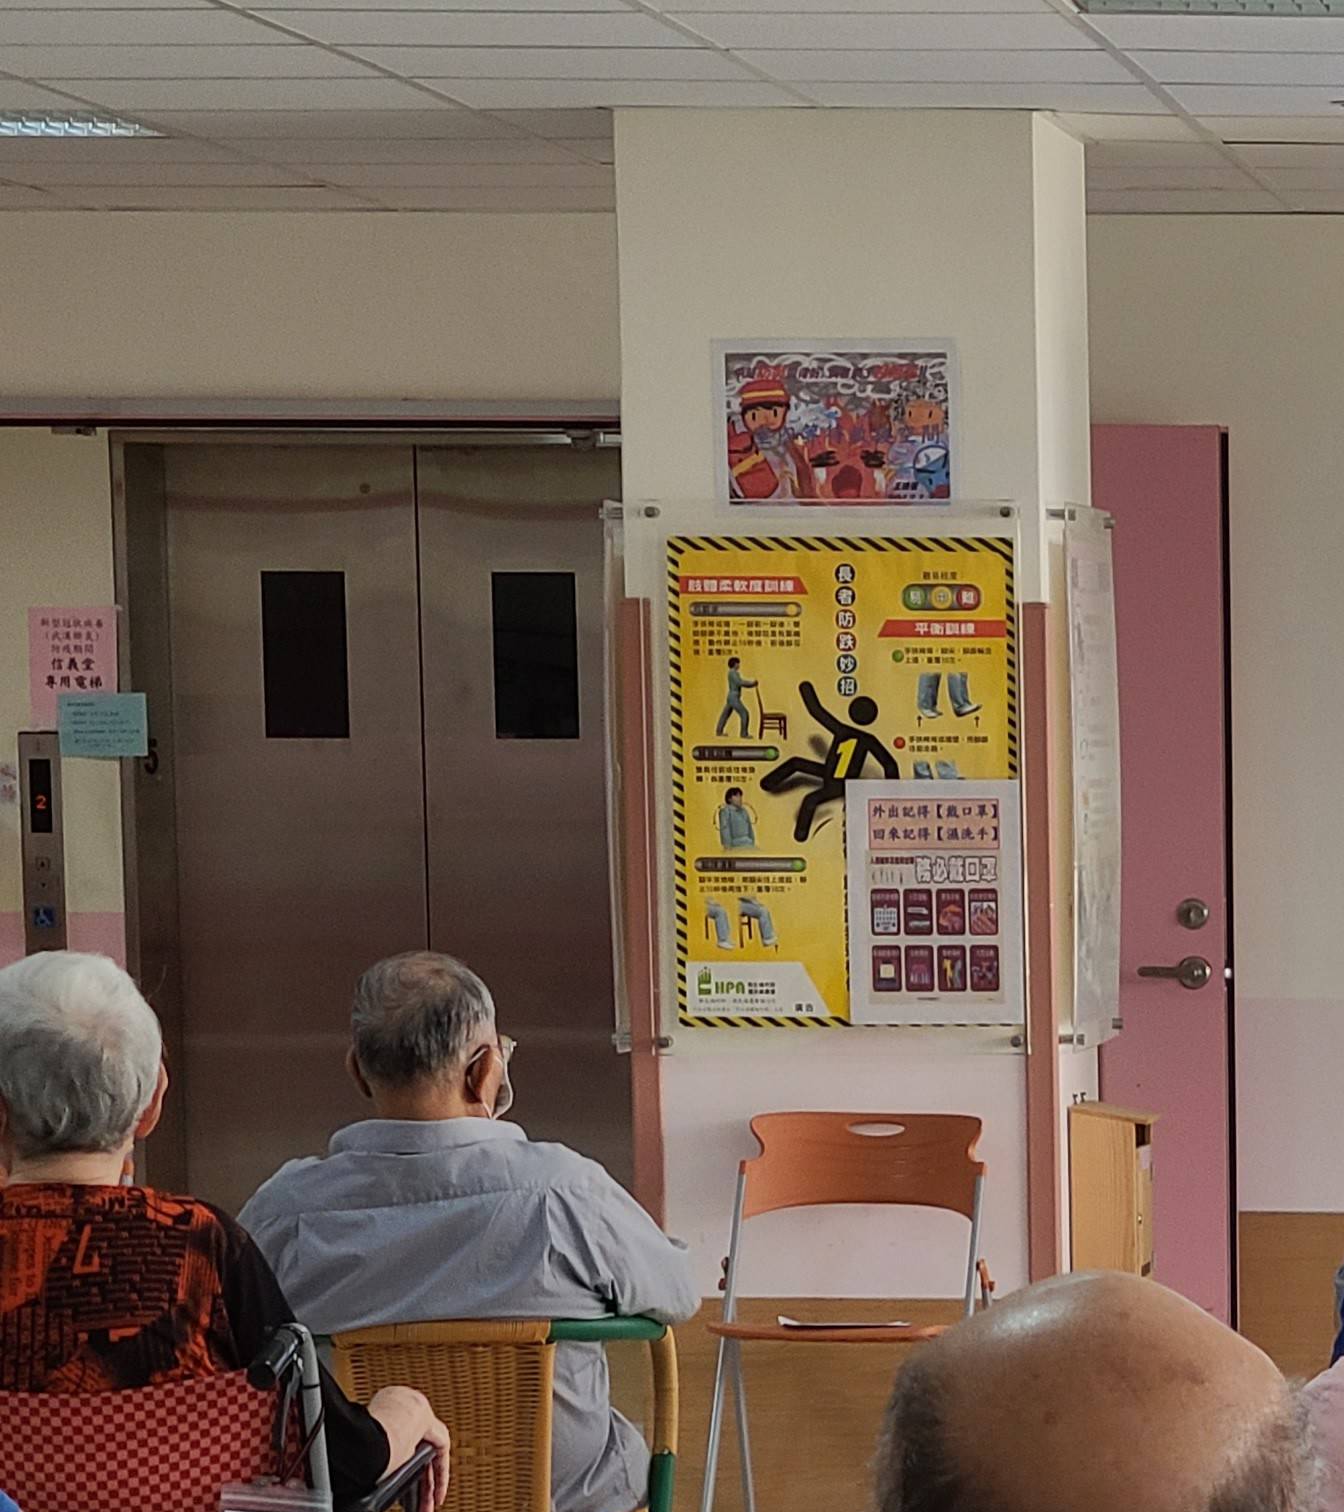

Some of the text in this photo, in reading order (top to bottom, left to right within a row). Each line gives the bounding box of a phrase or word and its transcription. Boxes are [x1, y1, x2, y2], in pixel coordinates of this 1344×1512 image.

[836, 565, 857, 696] 長者防跌妙招
[914, 622, 977, 636] 平衡訓練
[44, 675, 104, 690] 專用電梯
[833, 737, 858, 779] 1
[35, 794, 47, 810] 2
[872, 804, 999, 819] 外出記得【戴口罩】
[714, 981, 746, 995] HPA
